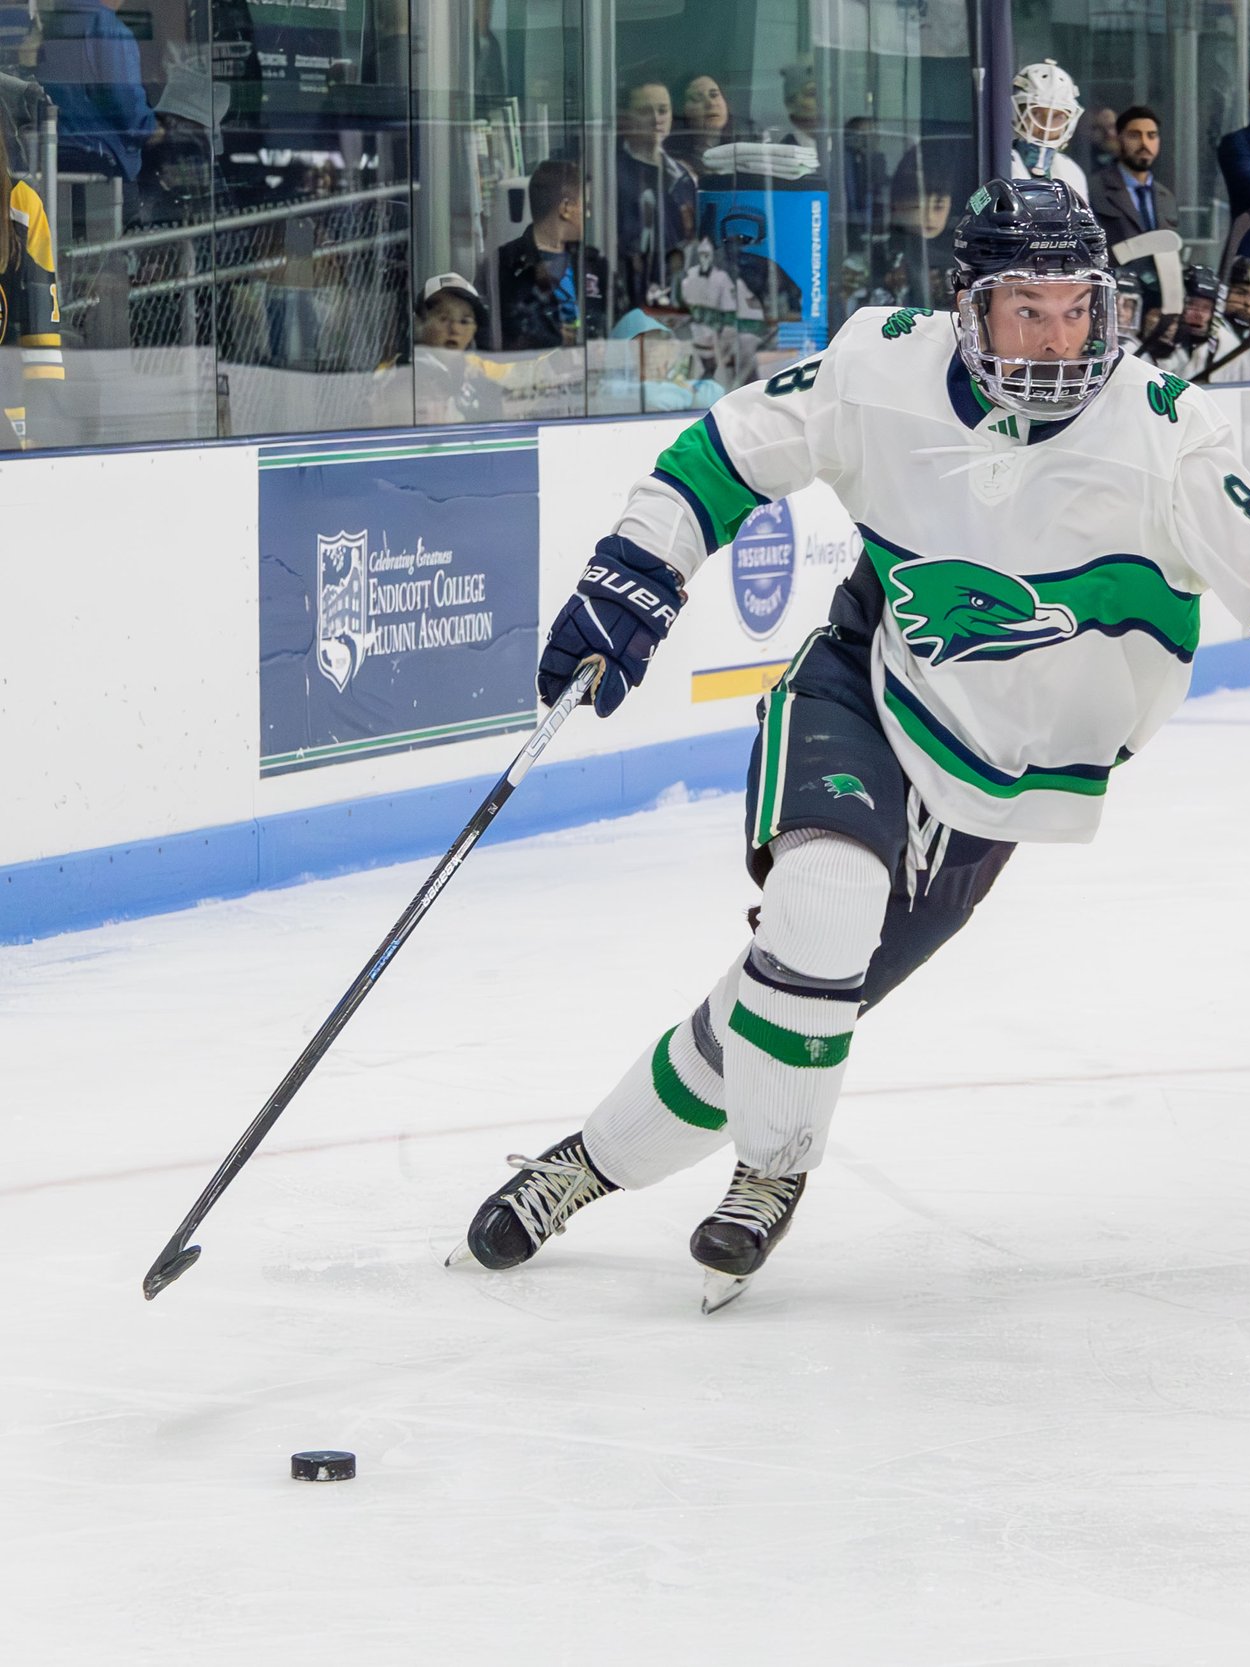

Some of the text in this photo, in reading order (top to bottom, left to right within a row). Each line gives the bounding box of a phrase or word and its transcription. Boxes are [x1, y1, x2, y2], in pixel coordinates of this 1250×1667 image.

[1030, 239, 1078, 249] BAUER
[737, 544, 792, 568] INSURANCE
[368, 569, 486, 616] ENDICOTT COLLEGE
[367, 612, 493, 656] ALUMNI ASSOCIATION
